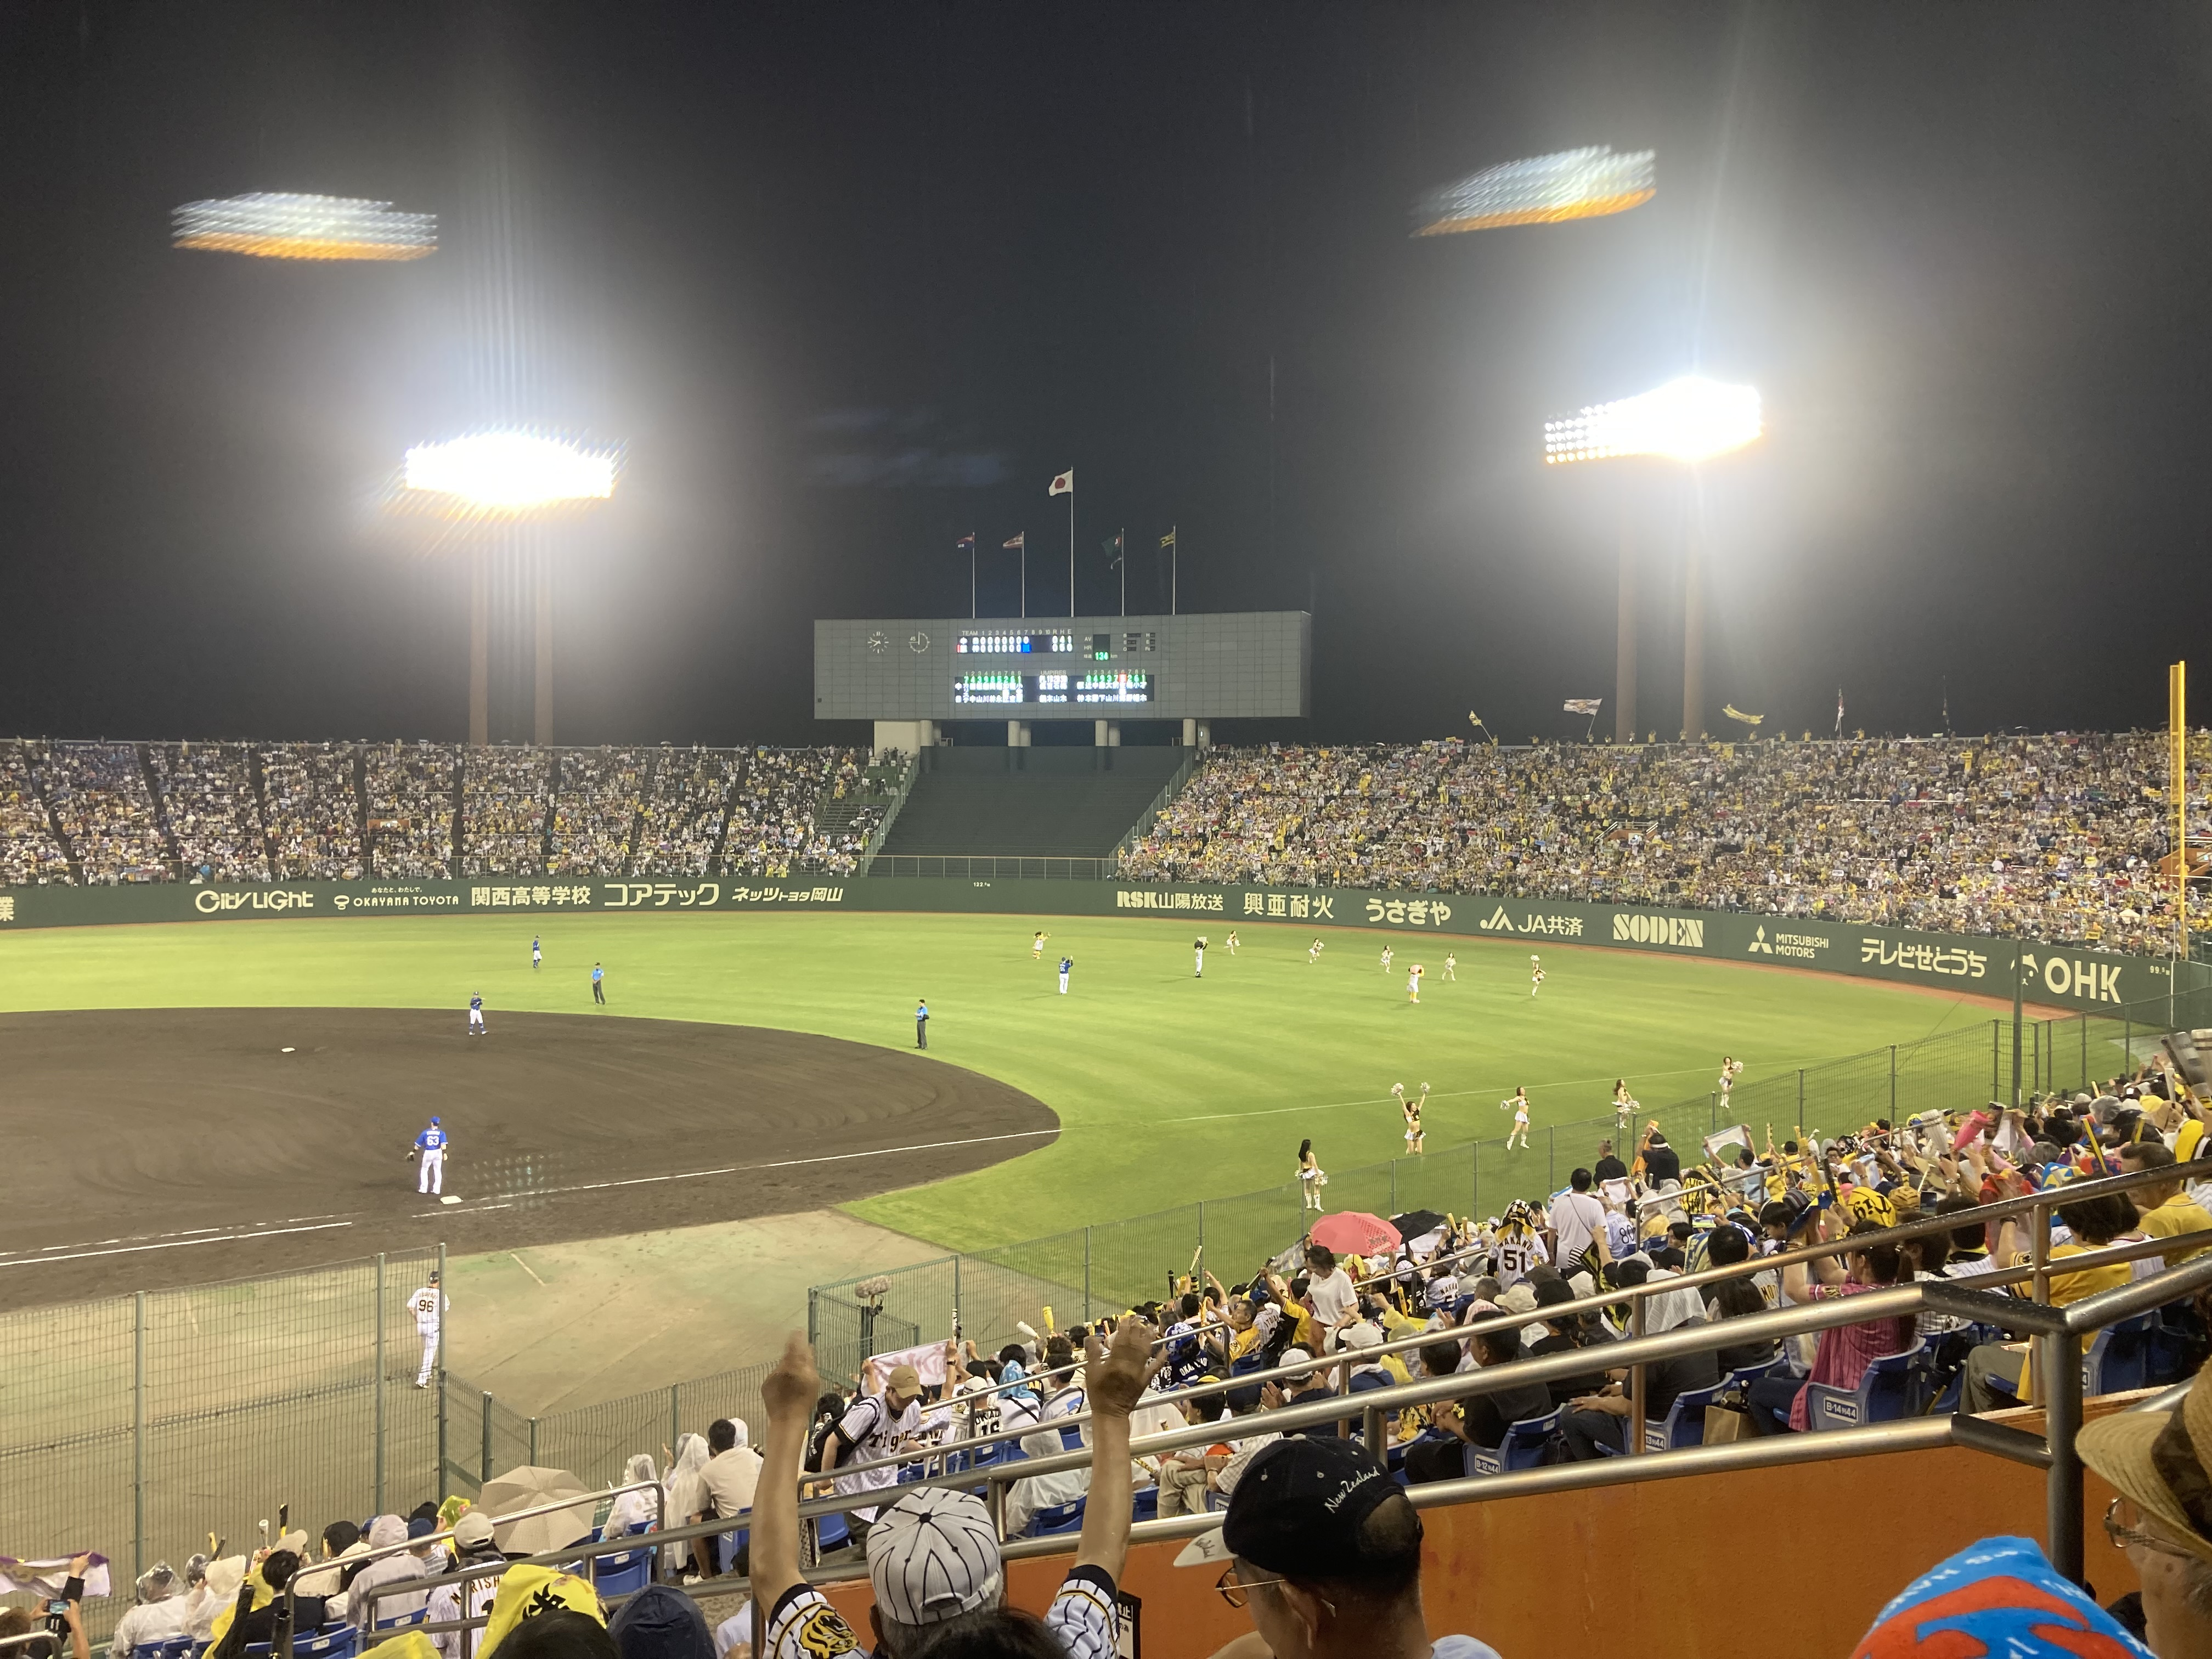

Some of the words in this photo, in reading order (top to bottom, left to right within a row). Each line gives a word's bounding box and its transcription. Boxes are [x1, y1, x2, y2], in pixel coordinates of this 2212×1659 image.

[353, 897, 409, 907] OKAYAMA
[413, 896, 459, 906] TOYOTA
[471, 885, 591, 906] 関西高等学校
[604, 883, 719, 906] コアテック
[1243, 892, 1334, 919] 興亜耐火
[1365, 898, 1451, 926] うさぎや
[1517, 914, 1583, 936] JA共済
[1613, 913, 1703, 948] SODEN
[1775, 933, 1829, 949] MITSUBISHI
[1775, 945, 1815, 959] MOTORS
[1861, 938, 1987, 978] テレビせとうち
[2044, 957, 2122, 1004] OHK
[427, 1136, 439, 1146] 63
[1619, 1224, 1635, 1244] 80
[1504, 1249, 1526, 1273] 51
[419, 1299, 434, 1312] 96
[868, 1429, 913, 1453] Tiger
[1324, 1489, 1346, 1514] New
[1340, 1465, 1381, 1493] Zealand
